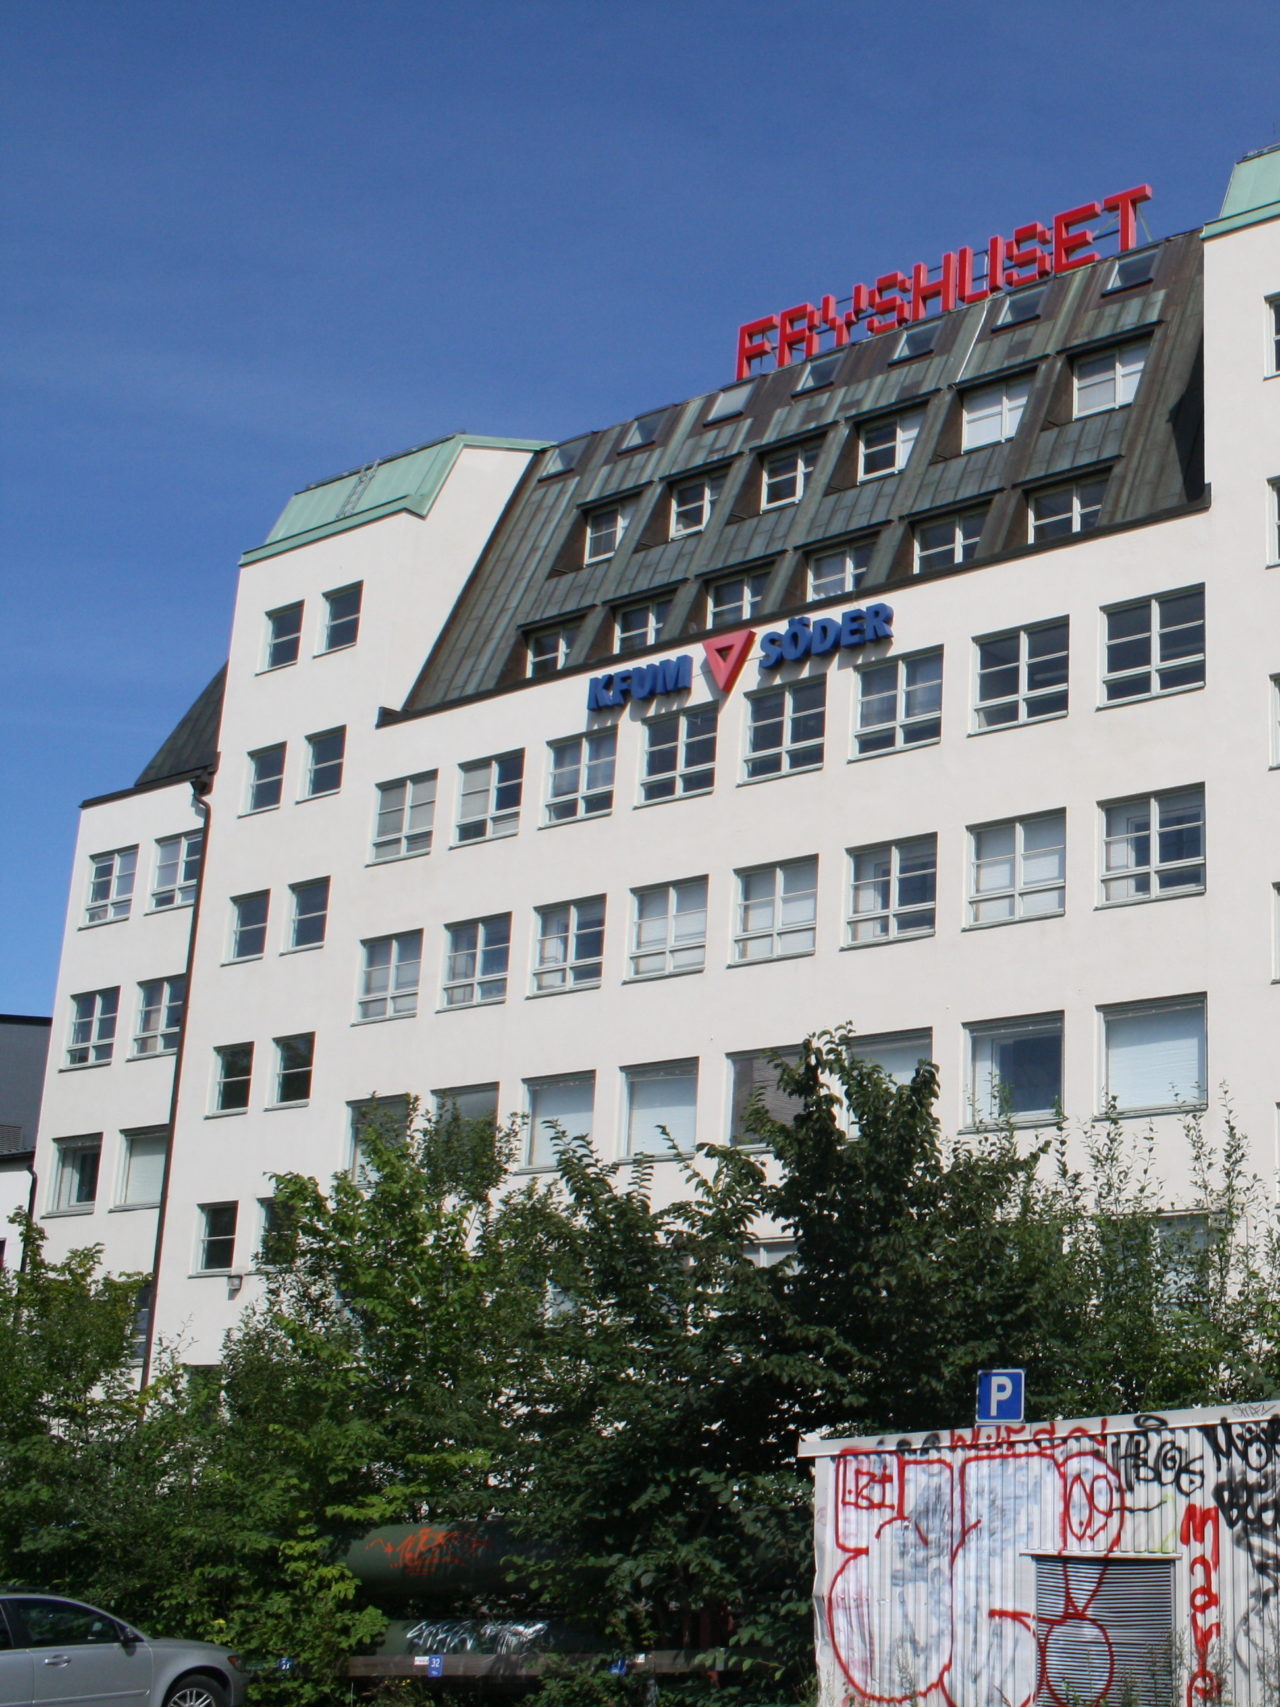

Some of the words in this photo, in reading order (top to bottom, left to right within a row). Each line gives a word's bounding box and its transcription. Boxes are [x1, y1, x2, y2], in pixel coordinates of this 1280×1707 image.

[735, 184, 1152, 381] FRYSHUSET
[587, 654, 693, 711] KFUM
[759, 602, 894, 670] SÖDER
[990, 1376, 1012, 1416] P
